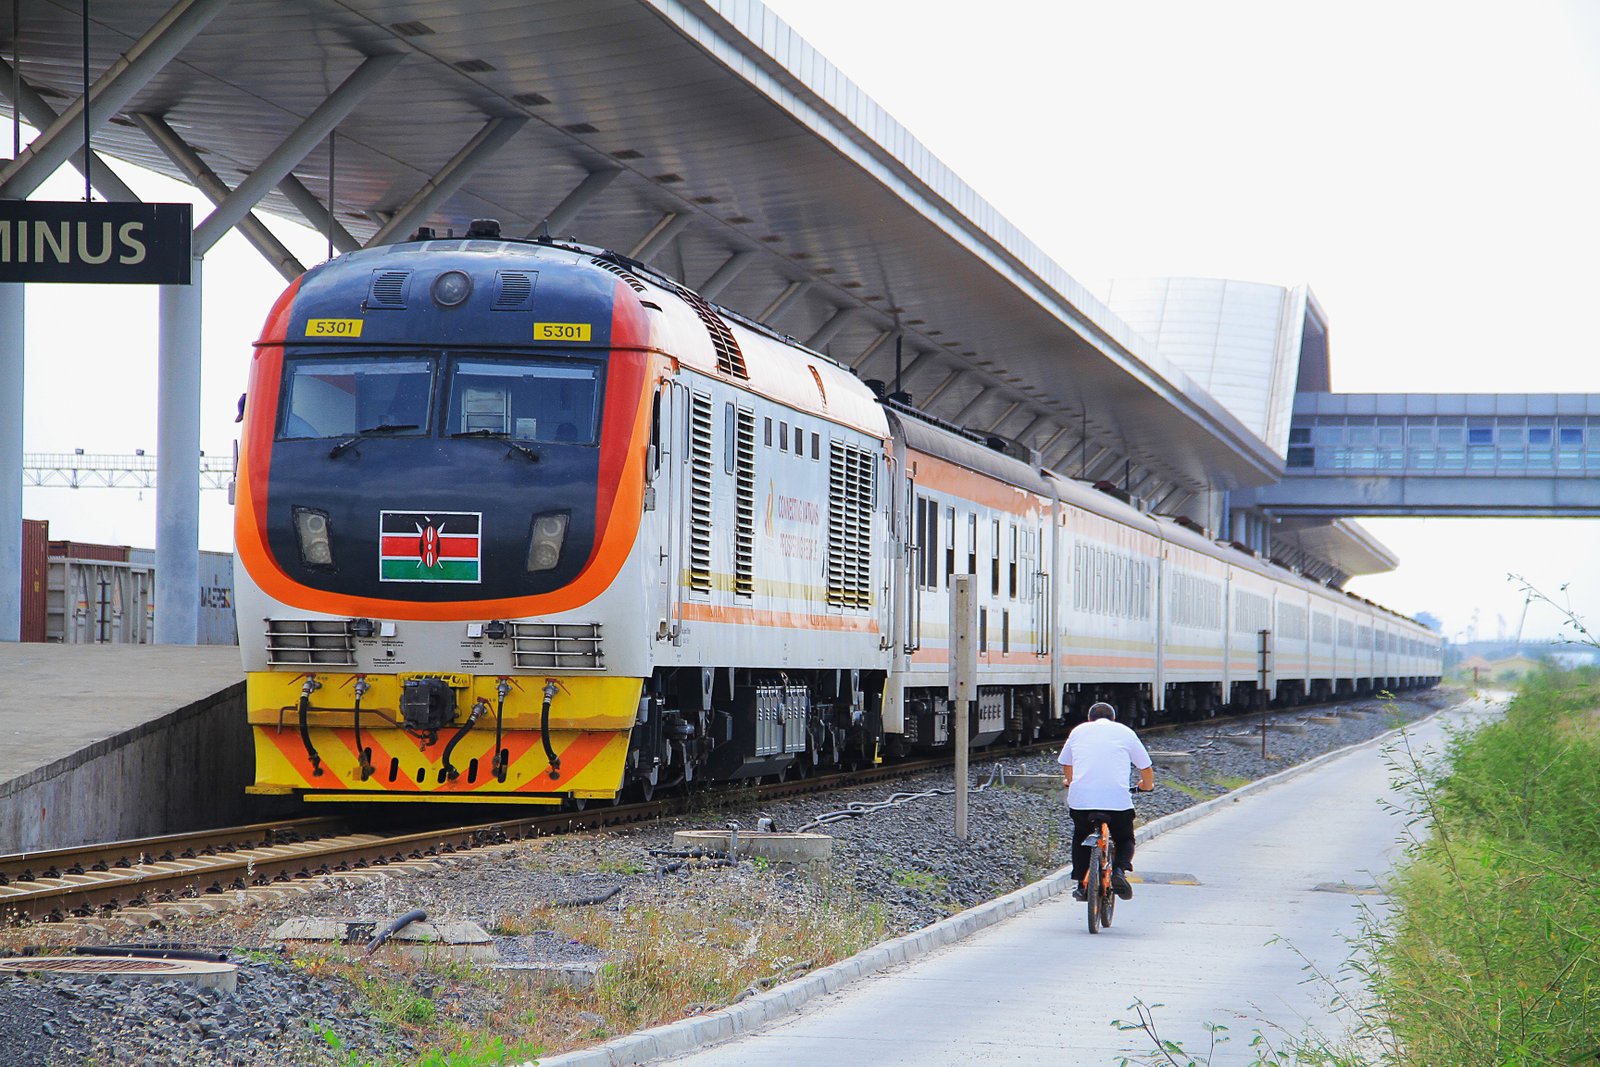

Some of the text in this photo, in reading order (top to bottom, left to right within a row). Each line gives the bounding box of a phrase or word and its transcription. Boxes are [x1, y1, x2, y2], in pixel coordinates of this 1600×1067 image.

[0, 220, 147, 265] INUS
[316, 321, 353, 334] 5301
[543, 325, 582, 339] 5301
